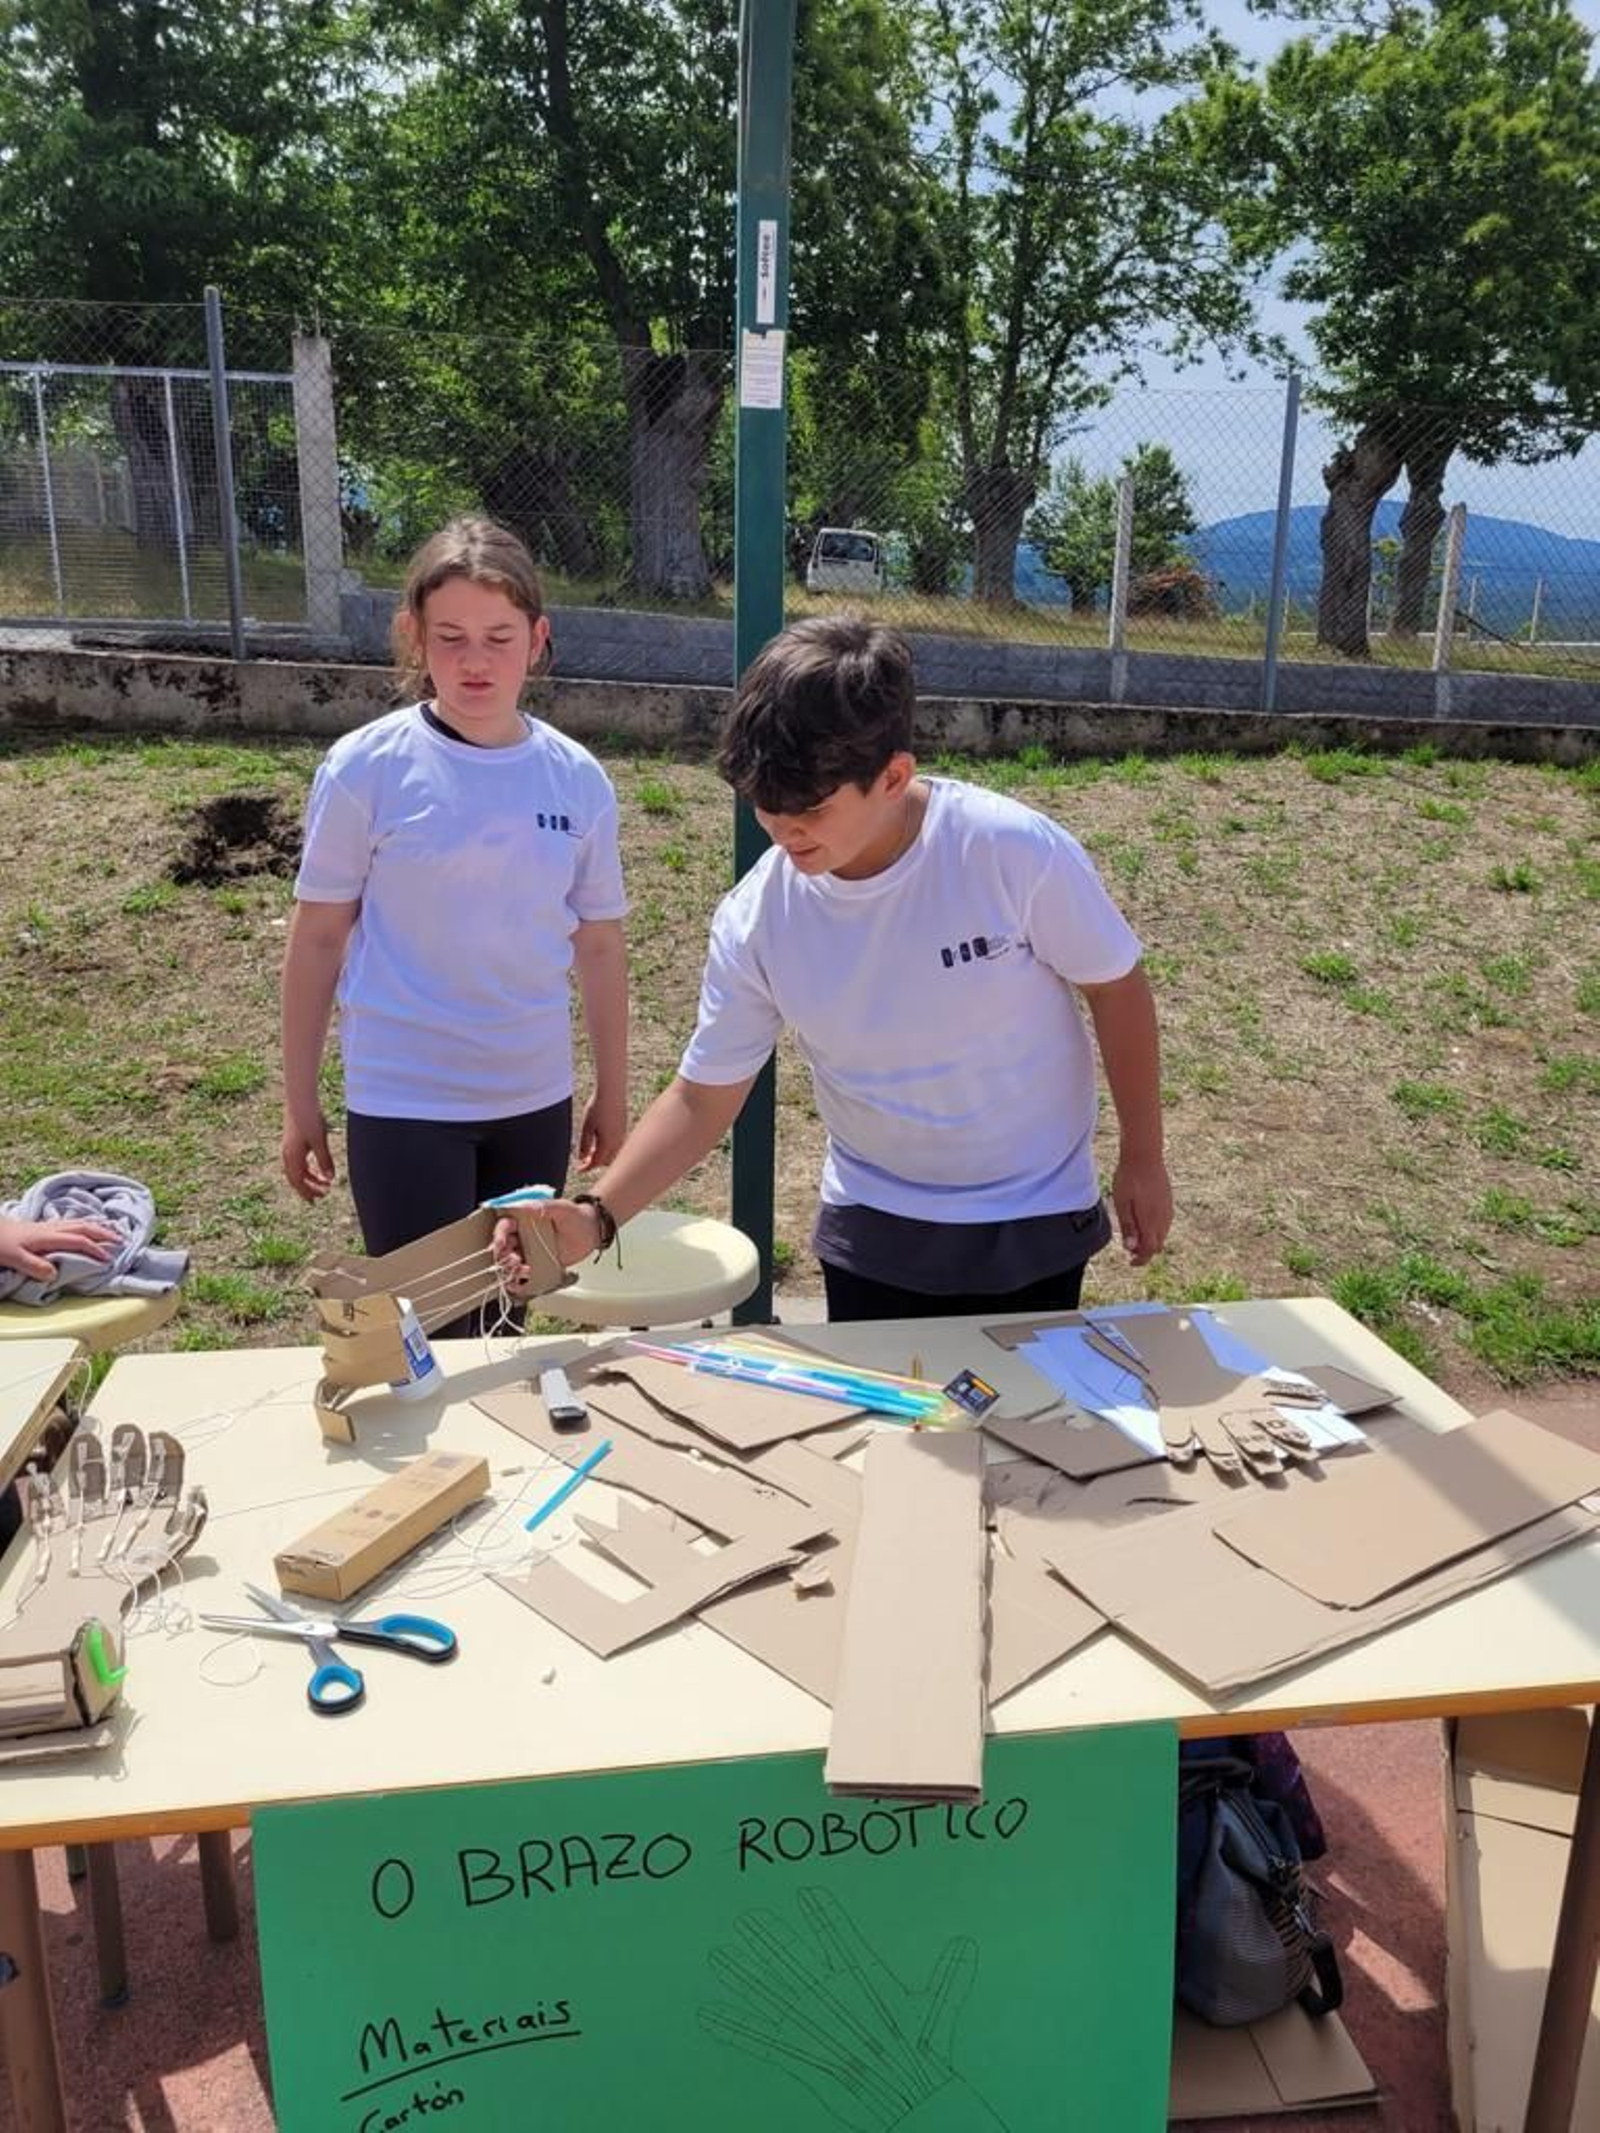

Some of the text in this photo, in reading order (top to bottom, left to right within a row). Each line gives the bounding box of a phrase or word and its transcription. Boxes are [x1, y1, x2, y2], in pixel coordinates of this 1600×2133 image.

[372, 1859, 414, 1918] O
[459, 1834, 692, 1907] BRAZO
[360, 2000, 571, 2074] Materiais
